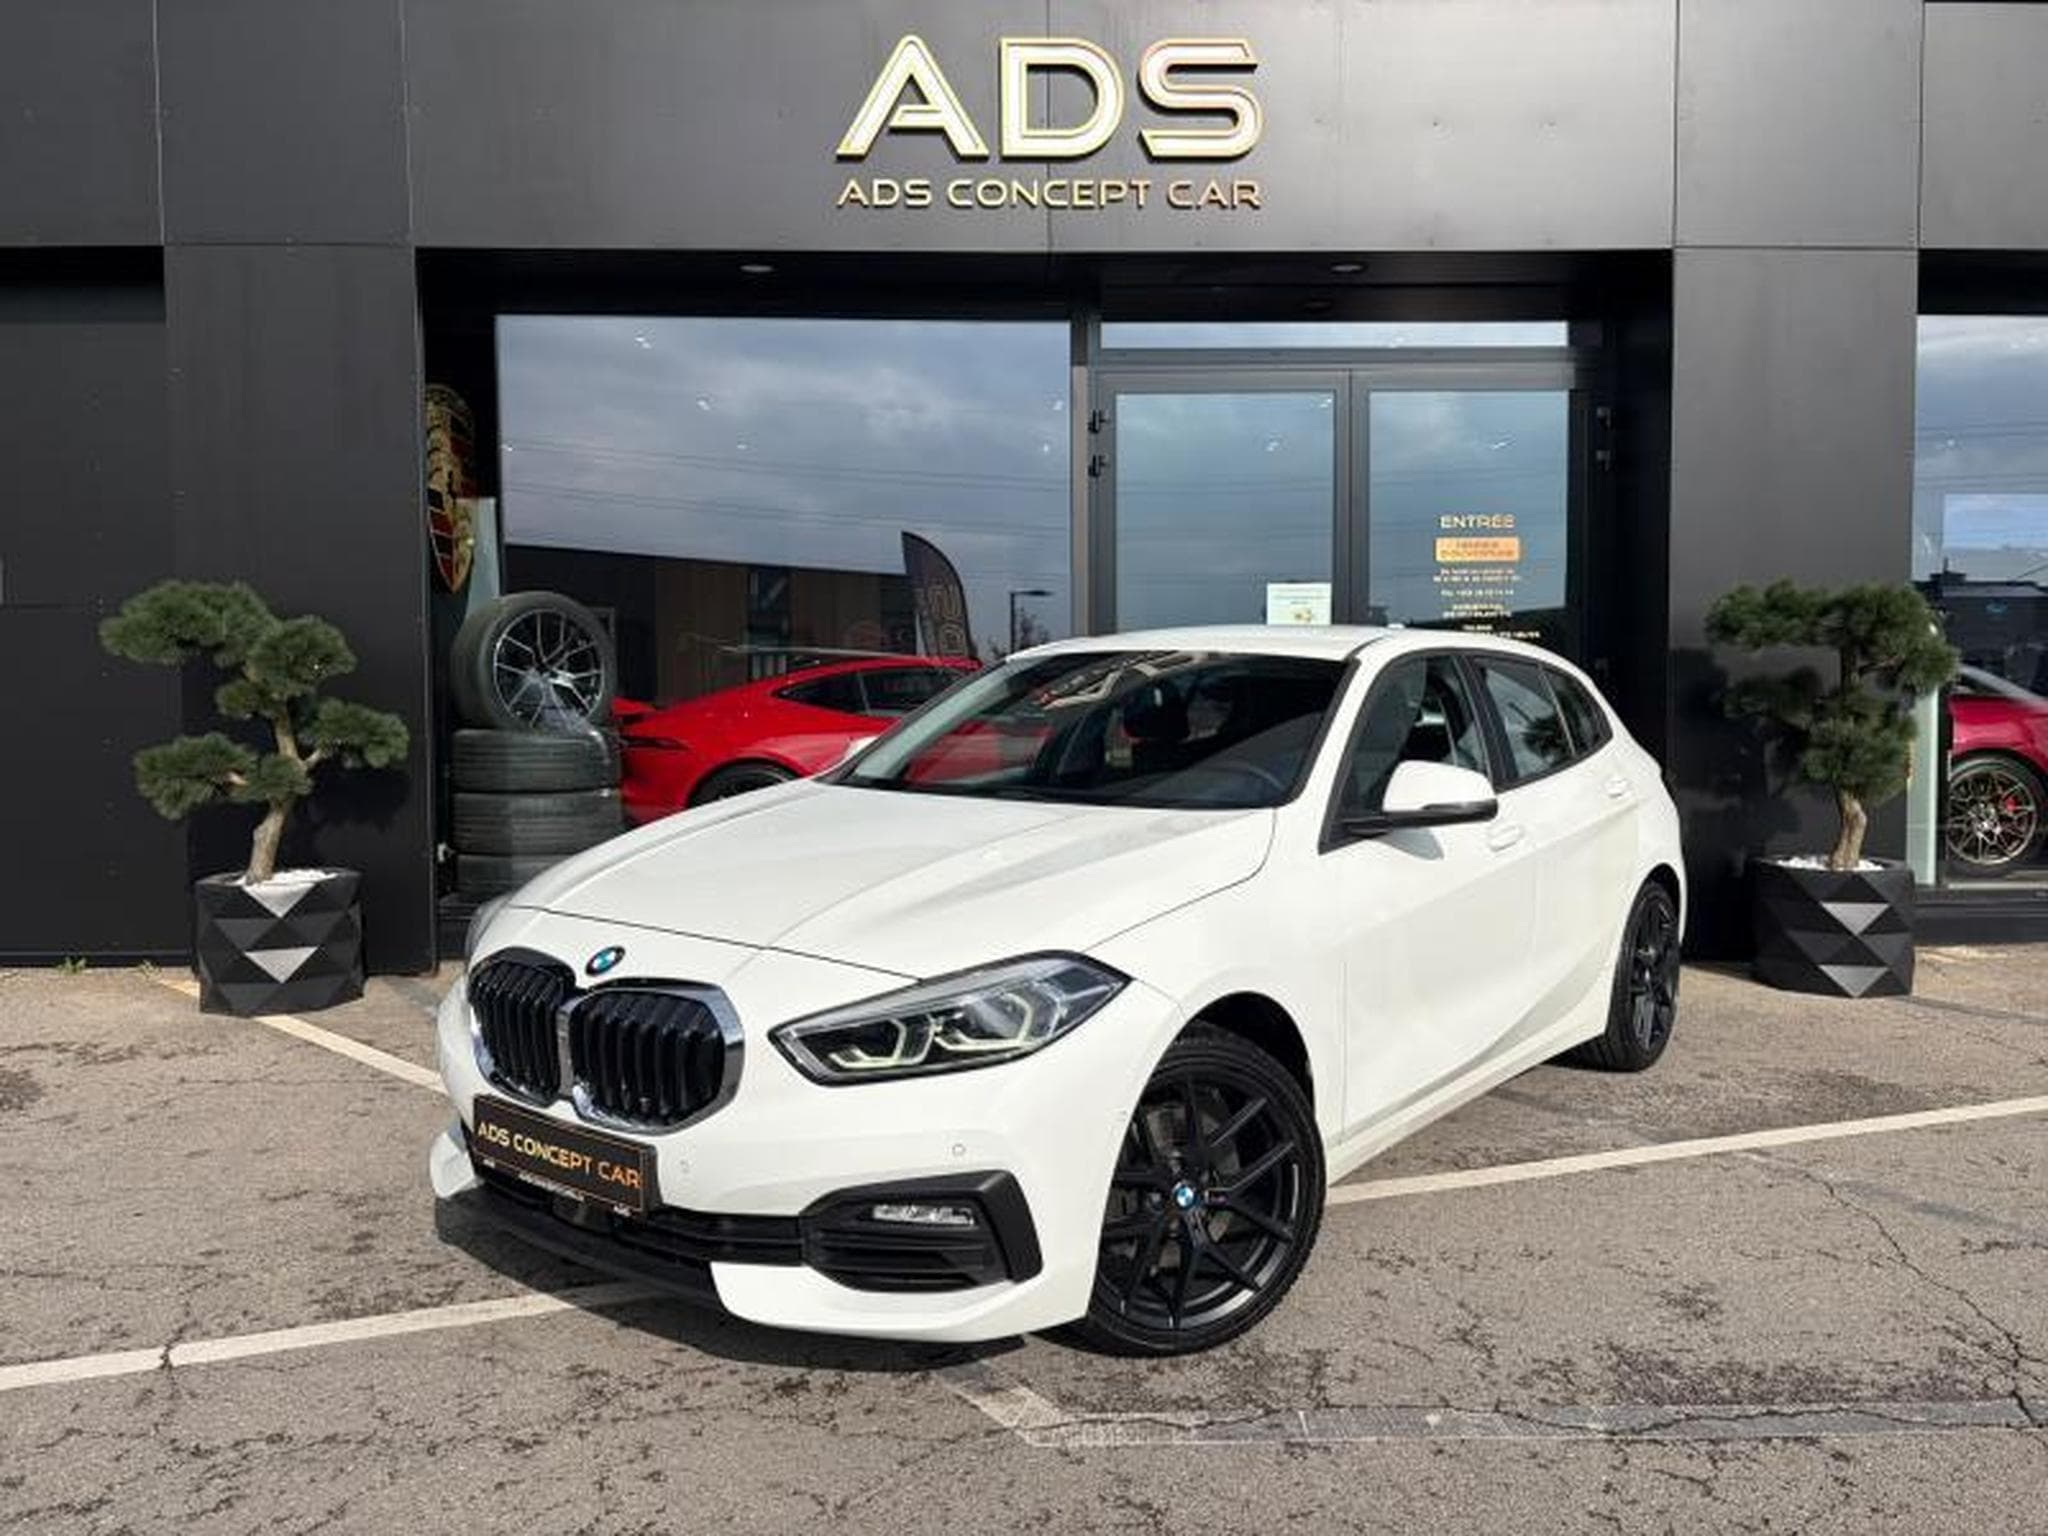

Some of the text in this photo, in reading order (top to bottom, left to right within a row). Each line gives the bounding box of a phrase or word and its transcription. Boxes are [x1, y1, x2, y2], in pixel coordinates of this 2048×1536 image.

[836, 34, 1264, 158] ADS
[837, 179, 1262, 208] ADS CONCEPT CAR
[477, 1122, 510, 1147] ADS
[513, 1132, 592, 1174] CONCEPT
[598, 1161, 642, 1189] CAR
